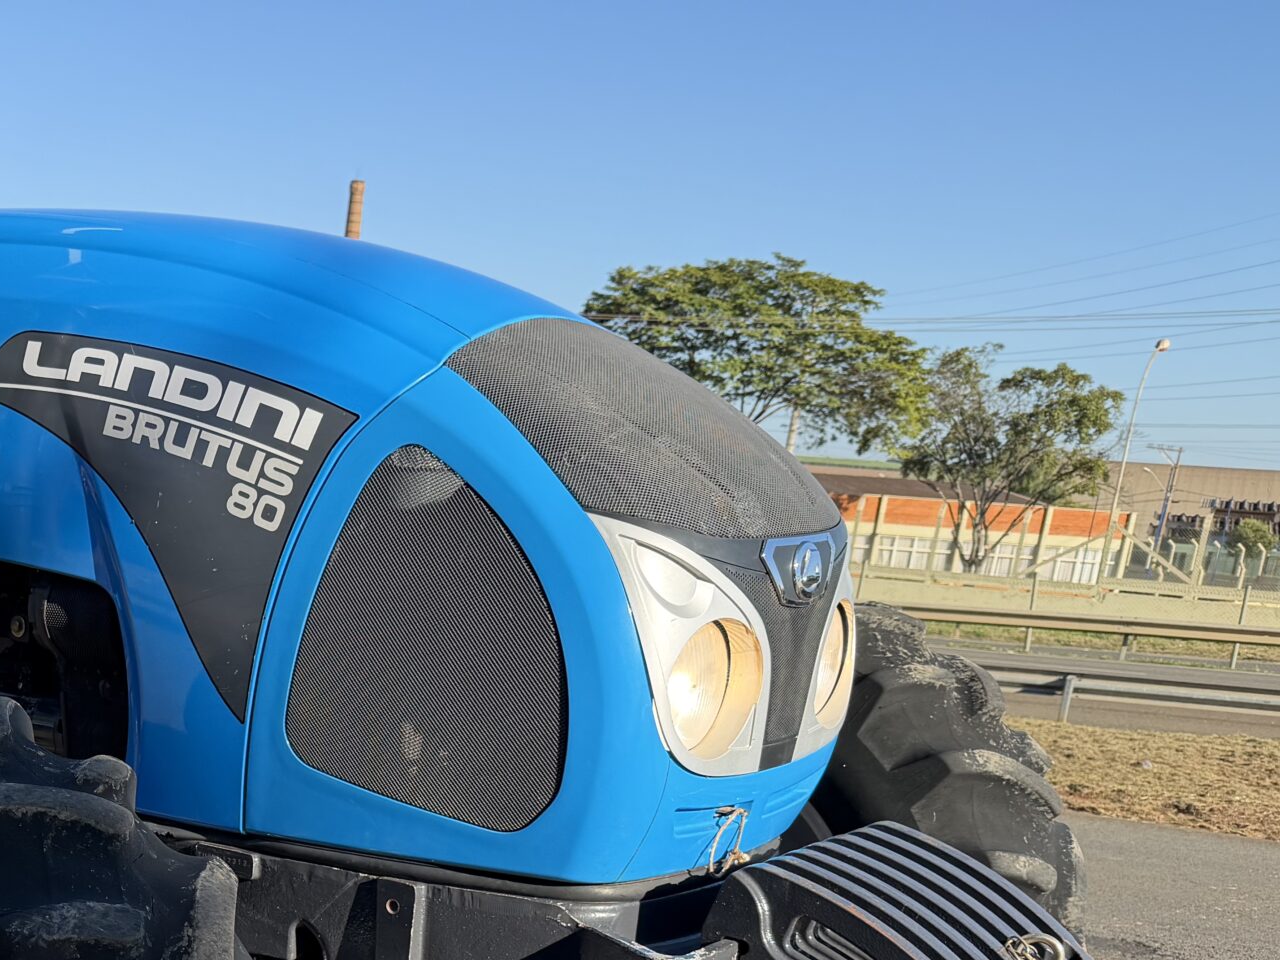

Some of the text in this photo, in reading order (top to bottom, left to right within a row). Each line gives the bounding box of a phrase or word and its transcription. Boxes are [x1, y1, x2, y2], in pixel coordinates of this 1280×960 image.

[22, 340, 323, 450] LANDINI
[102, 404, 300, 496] BRUTUS
[226, 482, 286, 532] 80
